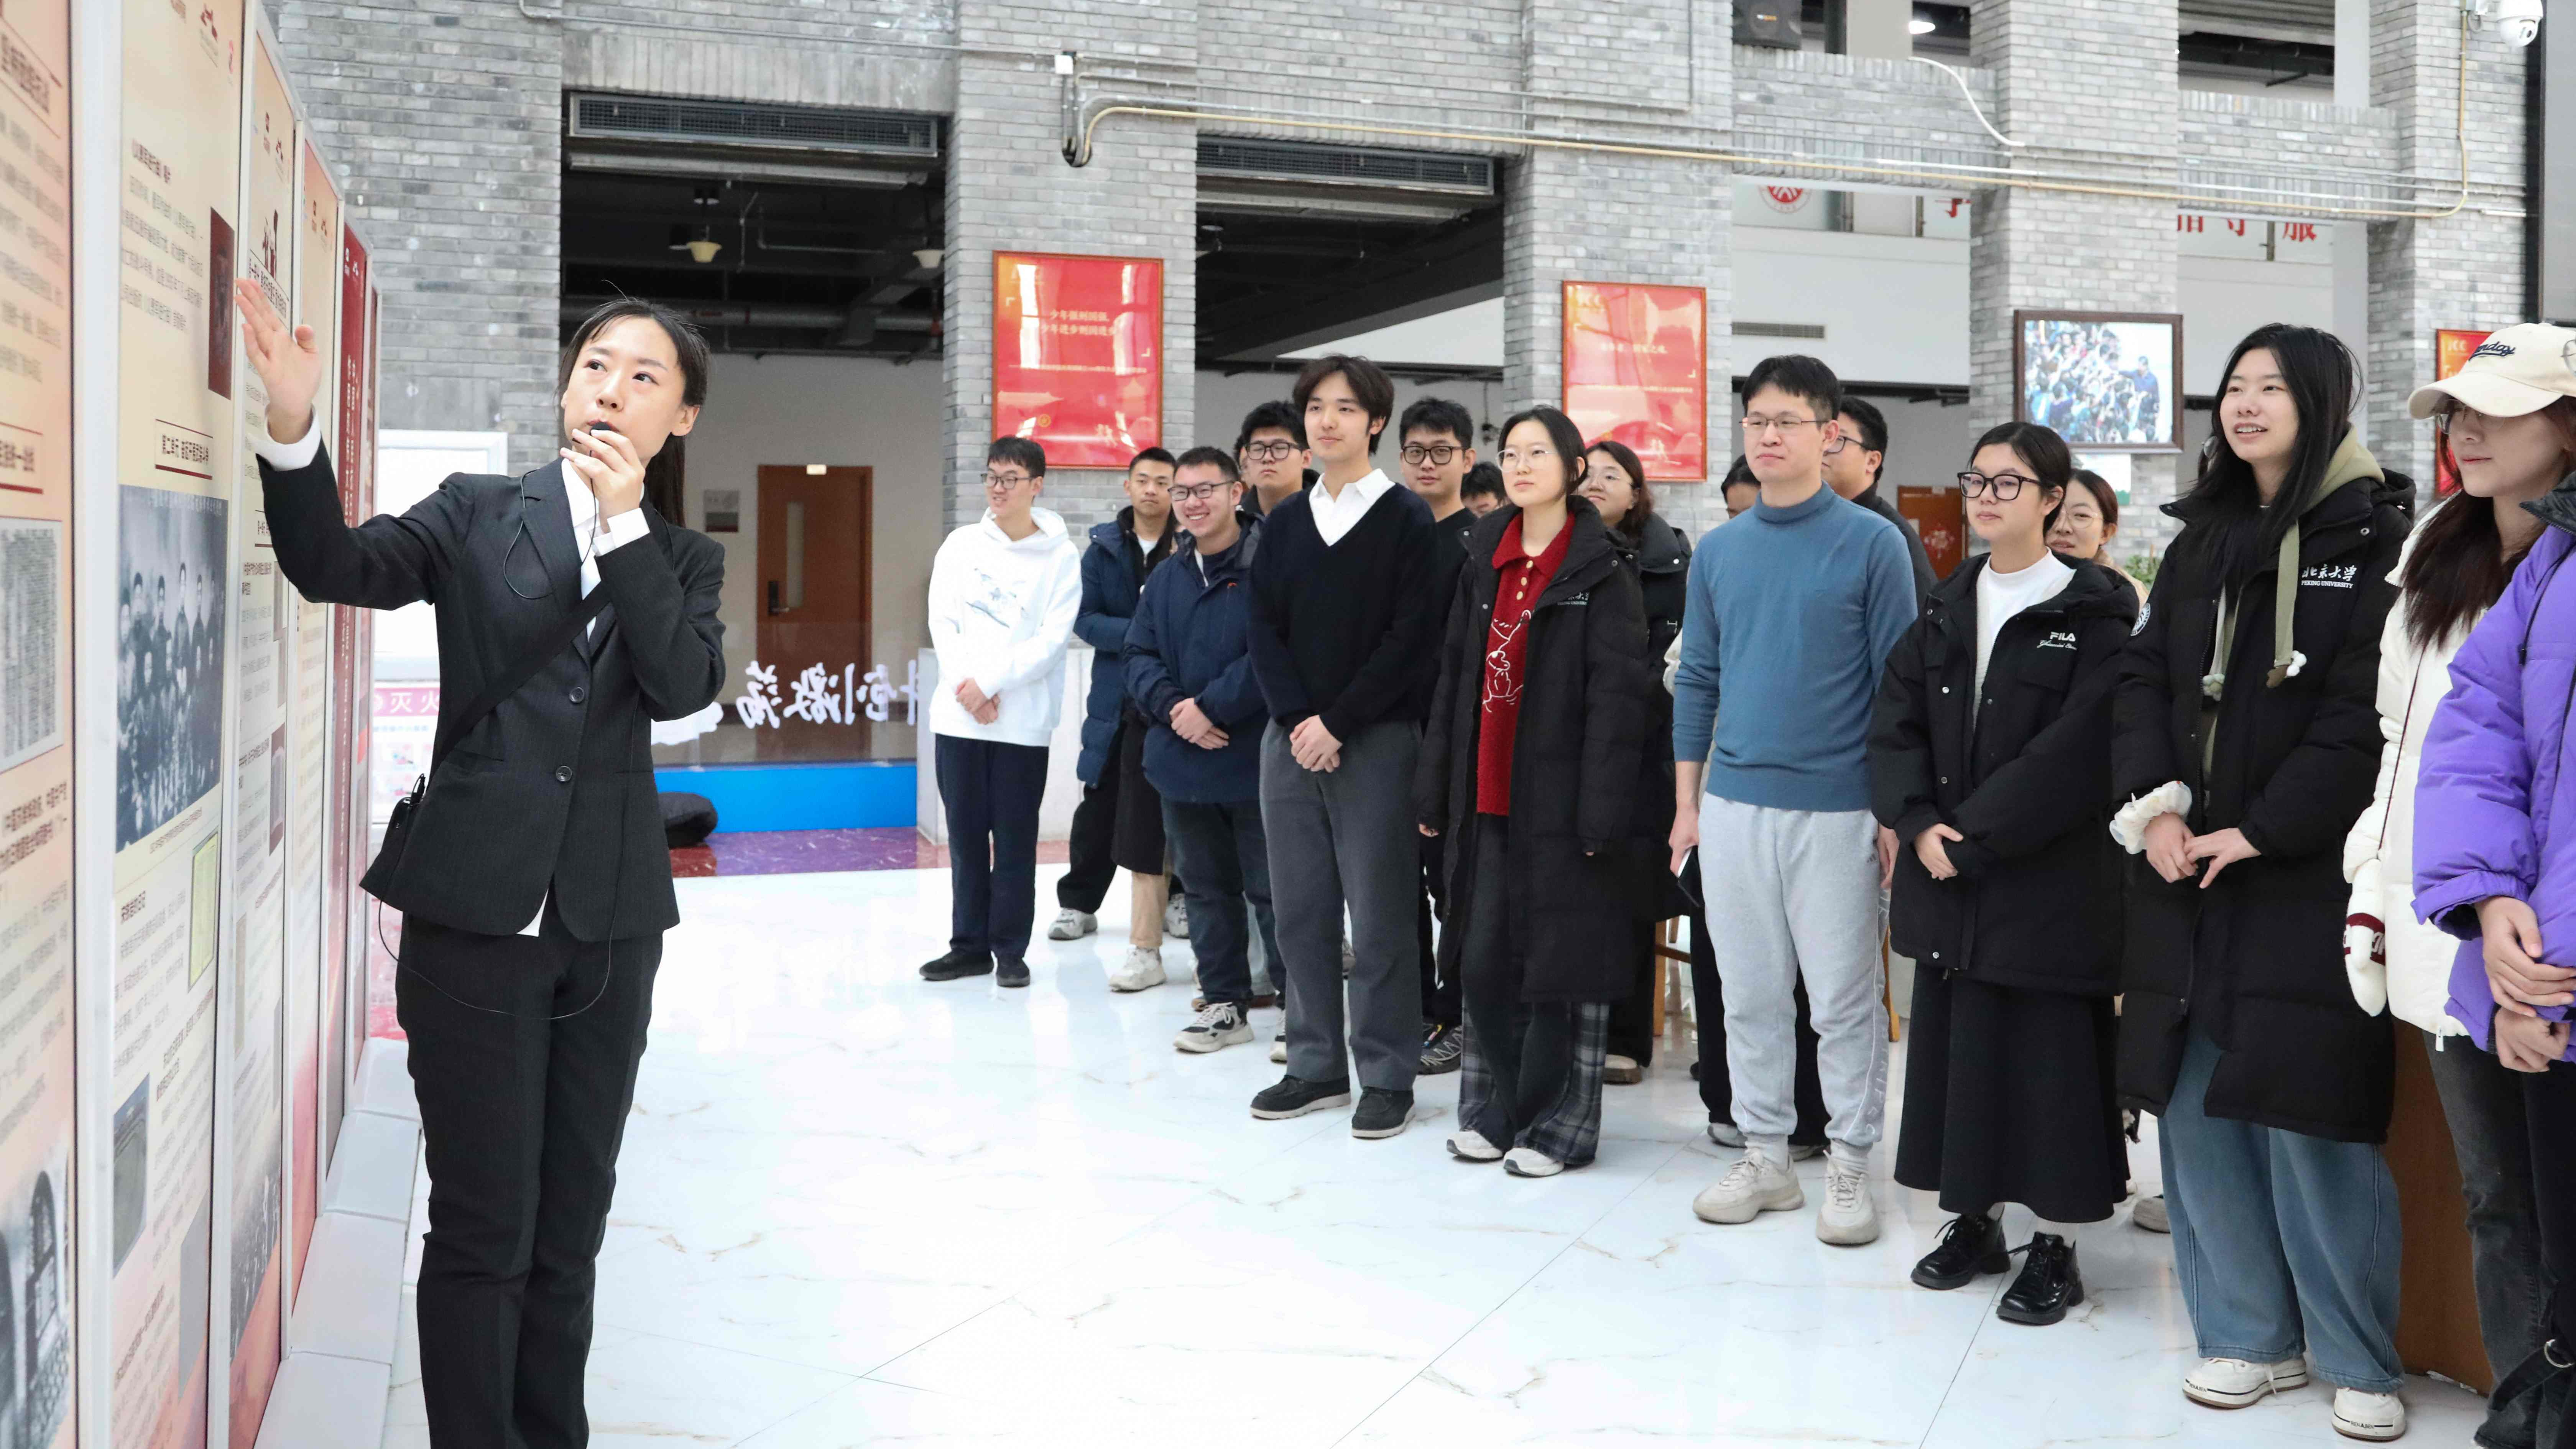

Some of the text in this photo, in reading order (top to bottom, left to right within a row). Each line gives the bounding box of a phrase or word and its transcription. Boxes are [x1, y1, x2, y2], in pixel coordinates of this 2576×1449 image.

[2301, 564, 2357, 581] 北京大学
[2321, 581, 2354, 589] UNIVERSITY
[2050, 632, 2076, 642] FILA
